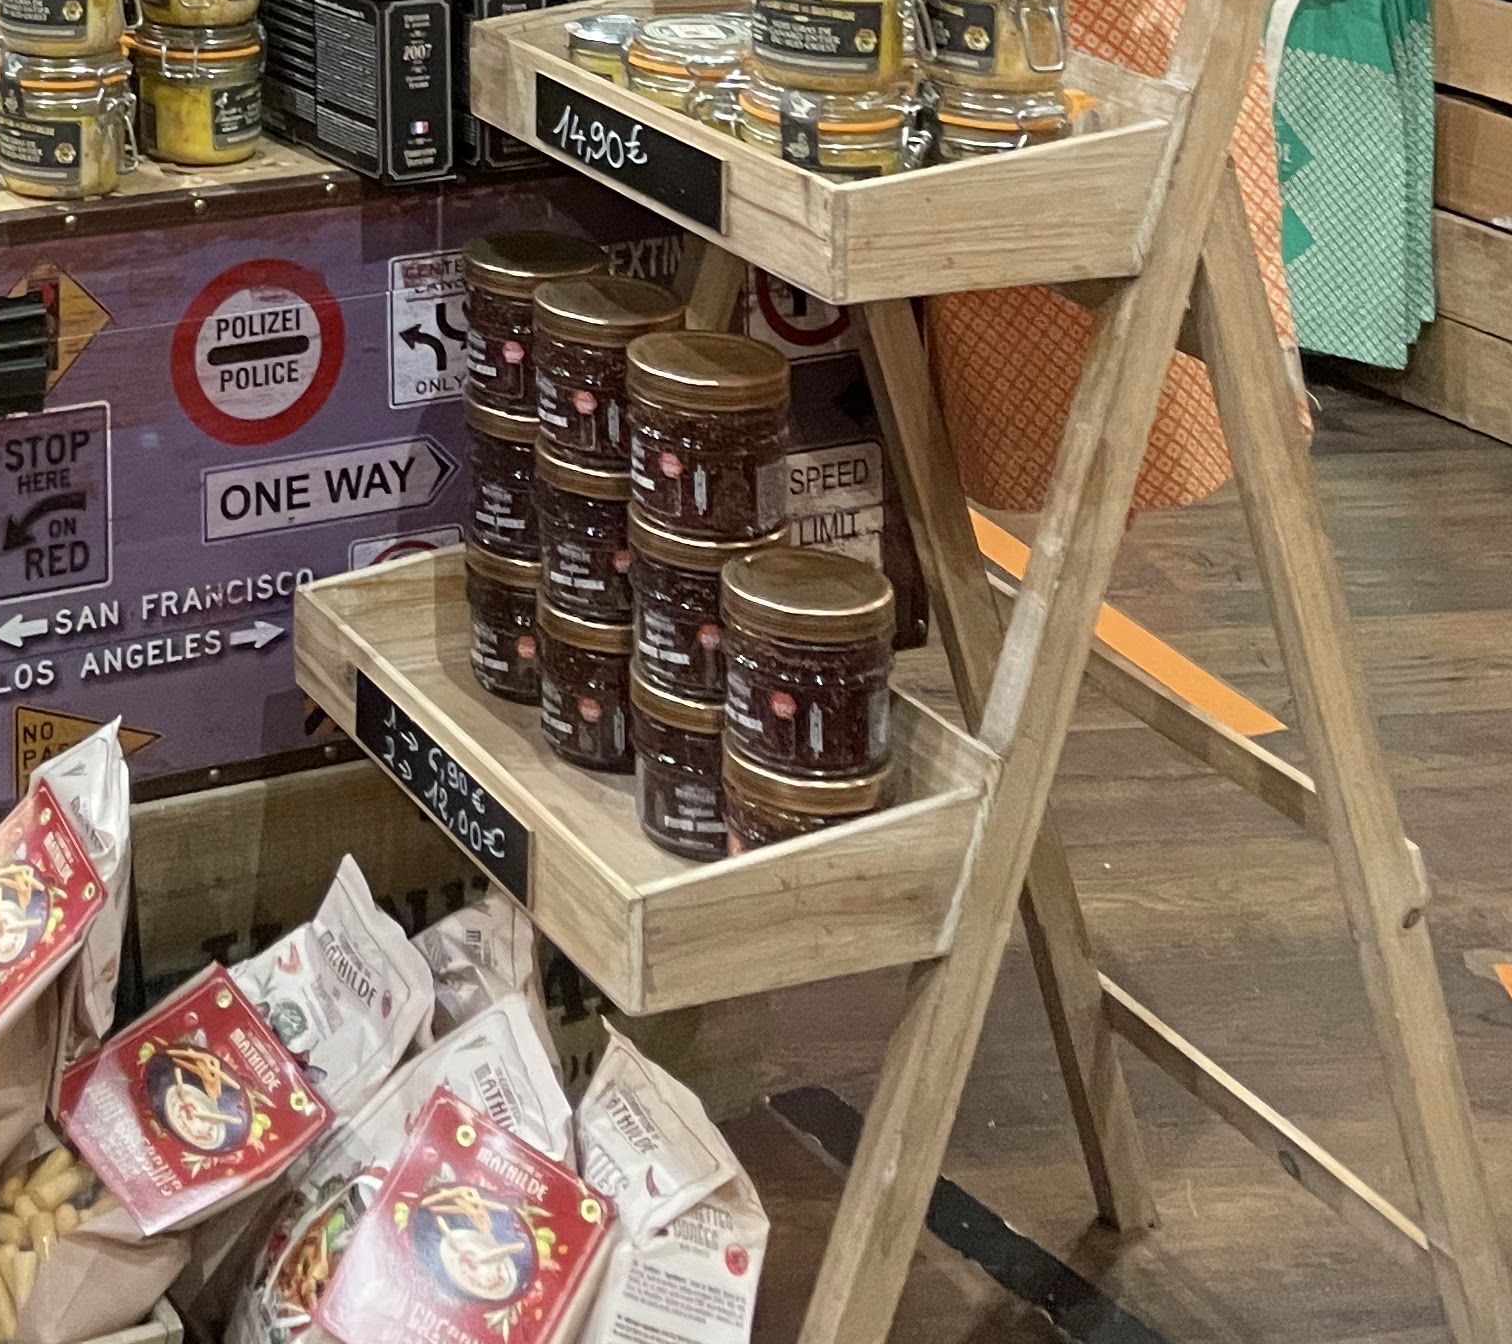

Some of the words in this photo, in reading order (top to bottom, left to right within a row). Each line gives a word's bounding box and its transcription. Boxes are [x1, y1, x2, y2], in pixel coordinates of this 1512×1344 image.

[402, 42, 433, 63] 2007
[552, 104, 649, 170] 14,90€
[405, 257, 467, 280] CENTE
[216, 309, 302, 342] POLIZEI
[220, 360, 300, 393] POLICE
[415, 373, 468, 396] ONLY
[4, 428, 91, 474] STOP
[17, 467, 72, 495] HERE
[219, 472, 311, 522] ONE
[324, 455, 416, 504] WAY
[789, 458, 870, 496] SPEED
[48, 517, 77, 539] ON
[797, 511, 861, 546] LIMIT
[24, 539, 90, 583] RED
[53, 600, 121, 637] SAN
[142, 567, 315, 621] FRANCISCO
[80, 629, 223, 680] ANGELES
[23, 722, 55, 745] NO
[317, 929, 379, 1010] MATHILDE
[229, 1027, 283, 1094] MATHILDE
[475, 1145, 549, 1203] MATHILDE
